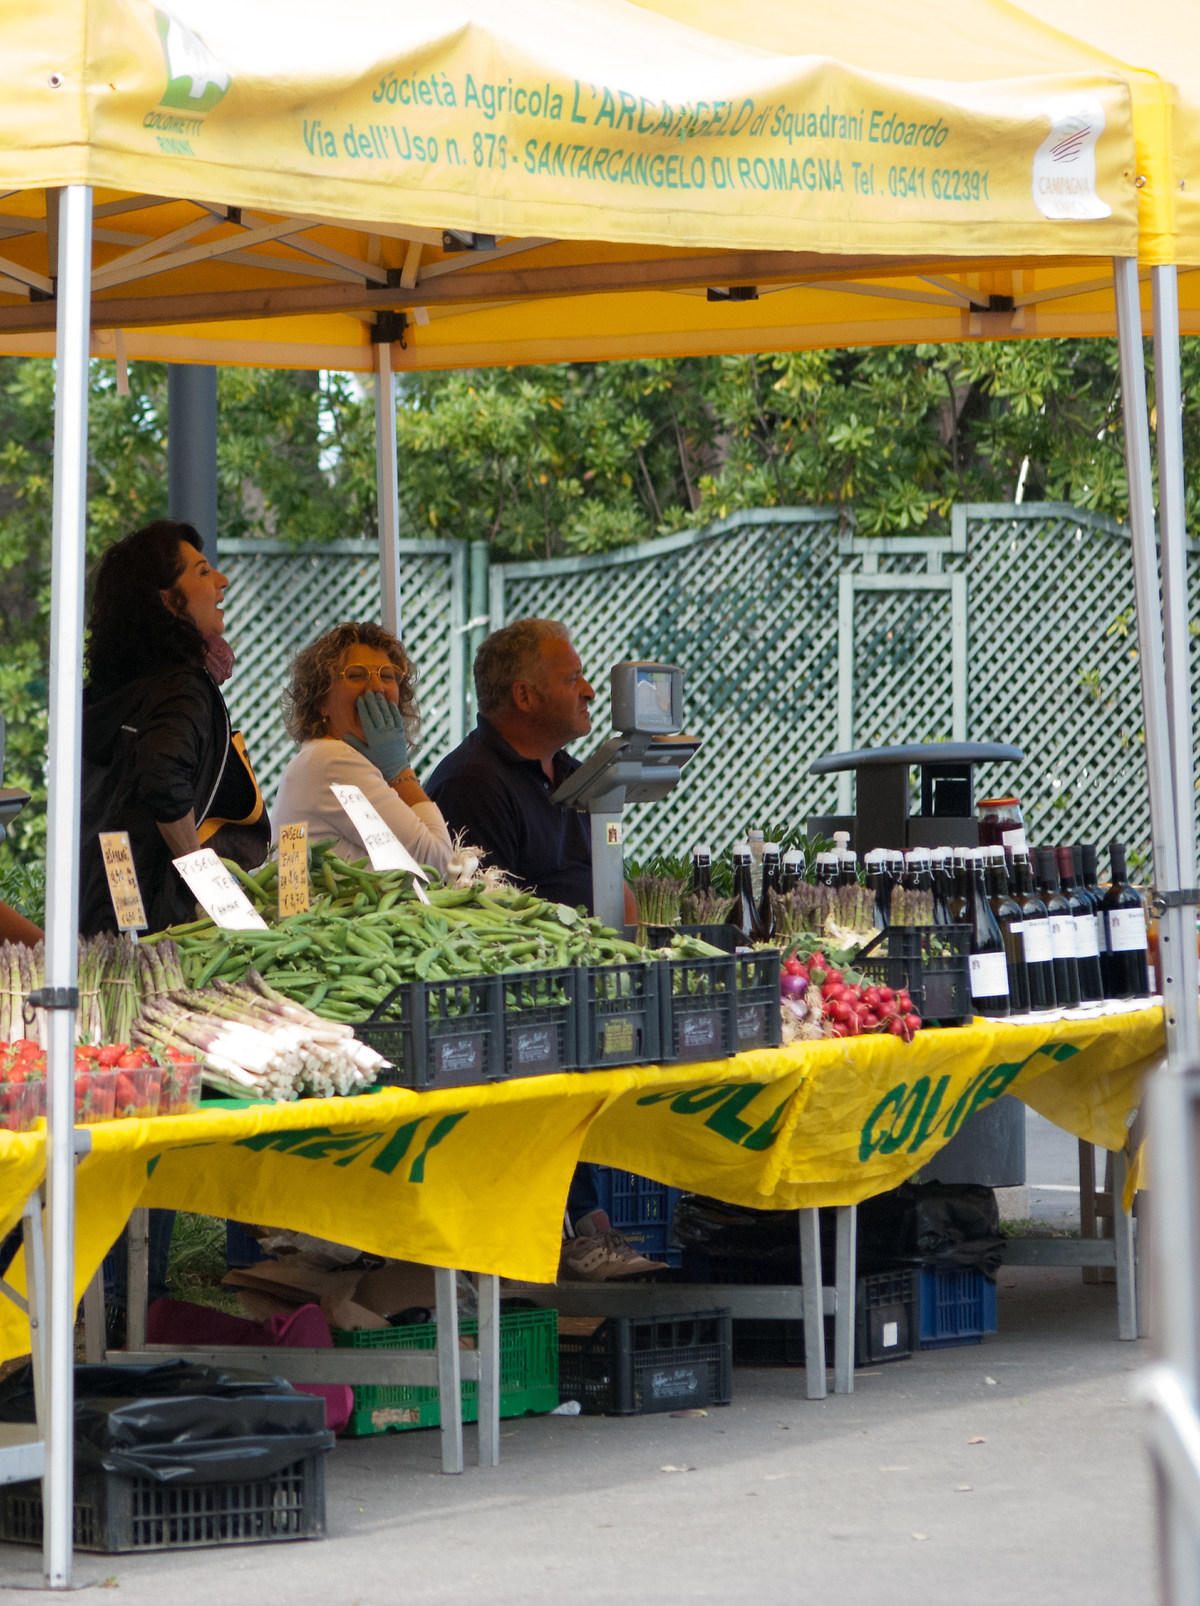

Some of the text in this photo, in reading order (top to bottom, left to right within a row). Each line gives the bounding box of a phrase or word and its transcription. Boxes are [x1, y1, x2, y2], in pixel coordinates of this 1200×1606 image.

[372, 70, 458, 107] Società
[464, 73, 563, 120] Agricola
[749, 105, 773, 137] di
[770, 104, 864, 146] Squadrani
[867, 110, 950, 148] Edoardo
[303, 119, 338, 158] Via
[343, 123, 438, 164] dell'Uso
[446, 138, 468, 166] n.
[524, 139, 705, 189] SANTARCANGELO
[711, 156, 736, 189] DI
[737, 157, 845, 193] ROMAGNA
[888, 165, 927, 199] 0541
[930, 168, 990, 201] 622391
[1039, 176, 1090, 196] CAMPAGNA
